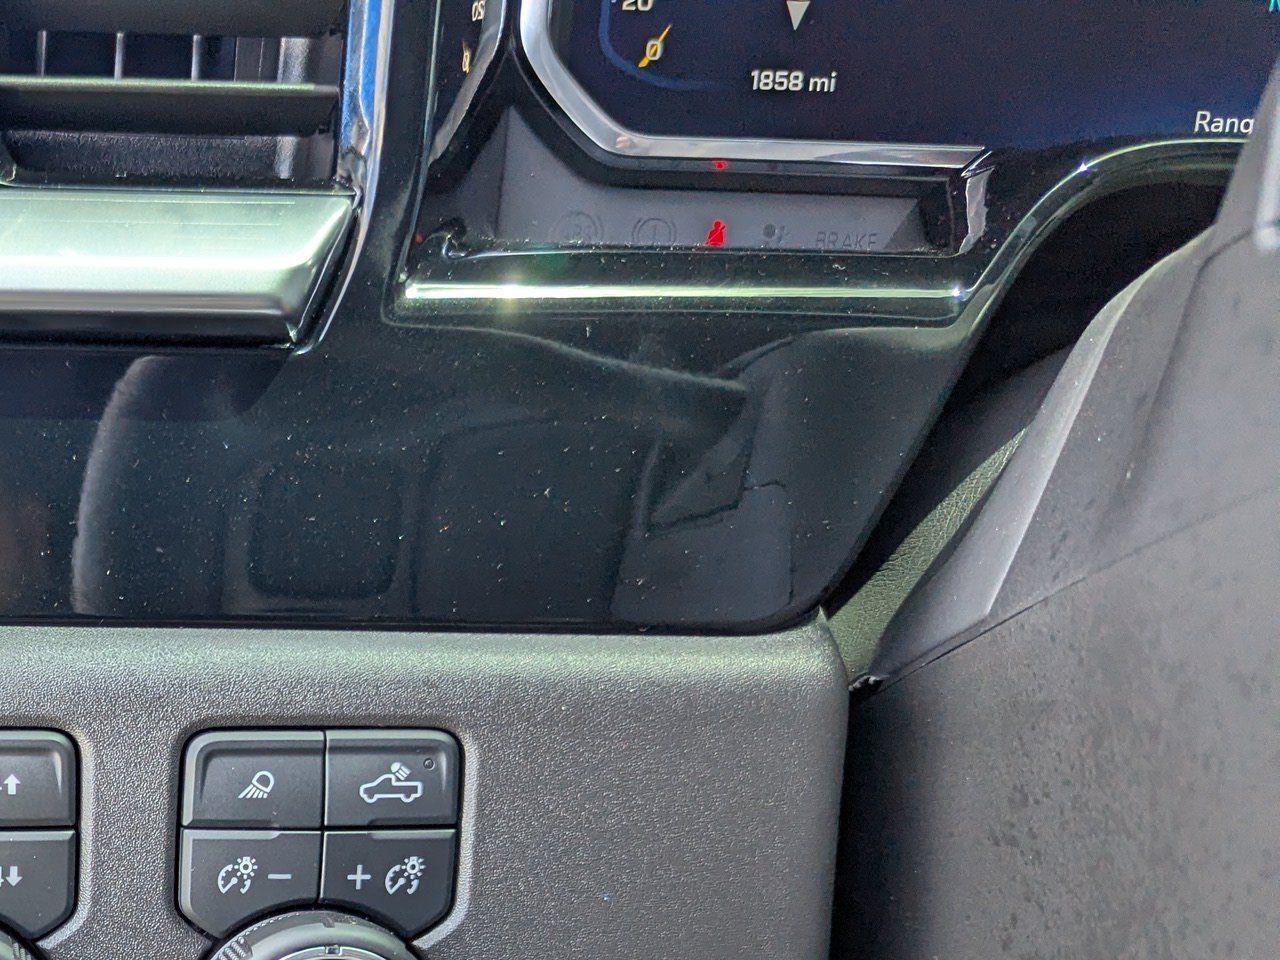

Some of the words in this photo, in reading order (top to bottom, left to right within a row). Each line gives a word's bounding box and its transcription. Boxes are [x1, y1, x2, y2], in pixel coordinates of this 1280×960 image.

[646, 39, 664, 60] 0
[751, 70, 804, 91] 1858
[808, 71, 837, 92] mi
[816, 231, 878, 249] BRAKE
